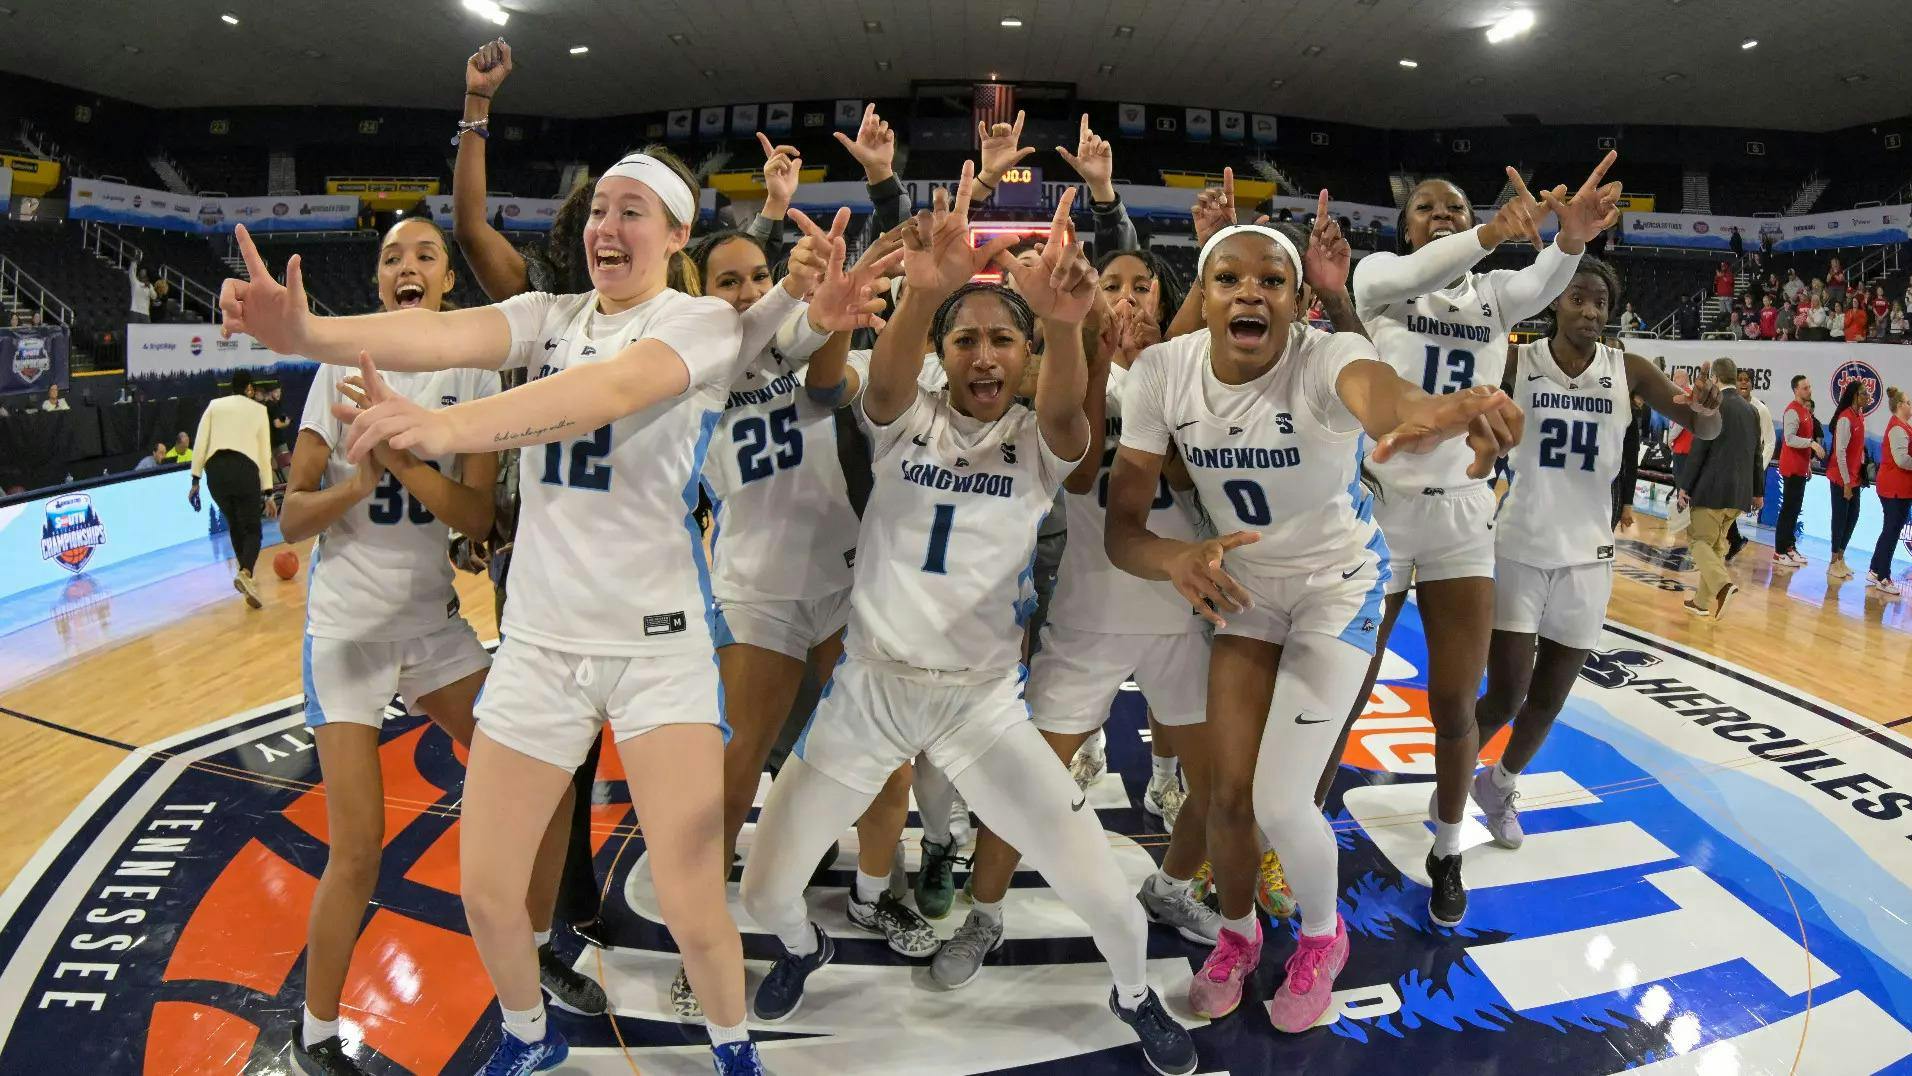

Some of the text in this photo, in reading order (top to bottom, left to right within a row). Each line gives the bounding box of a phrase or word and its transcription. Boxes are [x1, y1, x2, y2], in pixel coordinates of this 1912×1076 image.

[1407, 314, 1491, 343] LONGWOOD
[724, 370, 800, 410] NGWOOD
[1422, 344, 1475, 396] 13
[1532, 392, 1613, 414] LONGWOOD
[539, 423, 613, 492] 12
[732, 404, 803, 485] 25
[1182, 442, 1301, 469] LONGWOOD
[1539, 418, 1600, 472] 24
[901, 459, 1014, 498] LONGWOOD
[1222, 479, 1273, 526] 0
[920, 503, 956, 575] 1
[673, 617, 682, 627] M
[1628, 678, 1912, 820] HERCULES
[37, 801, 217, 1012] TENNESSEE
